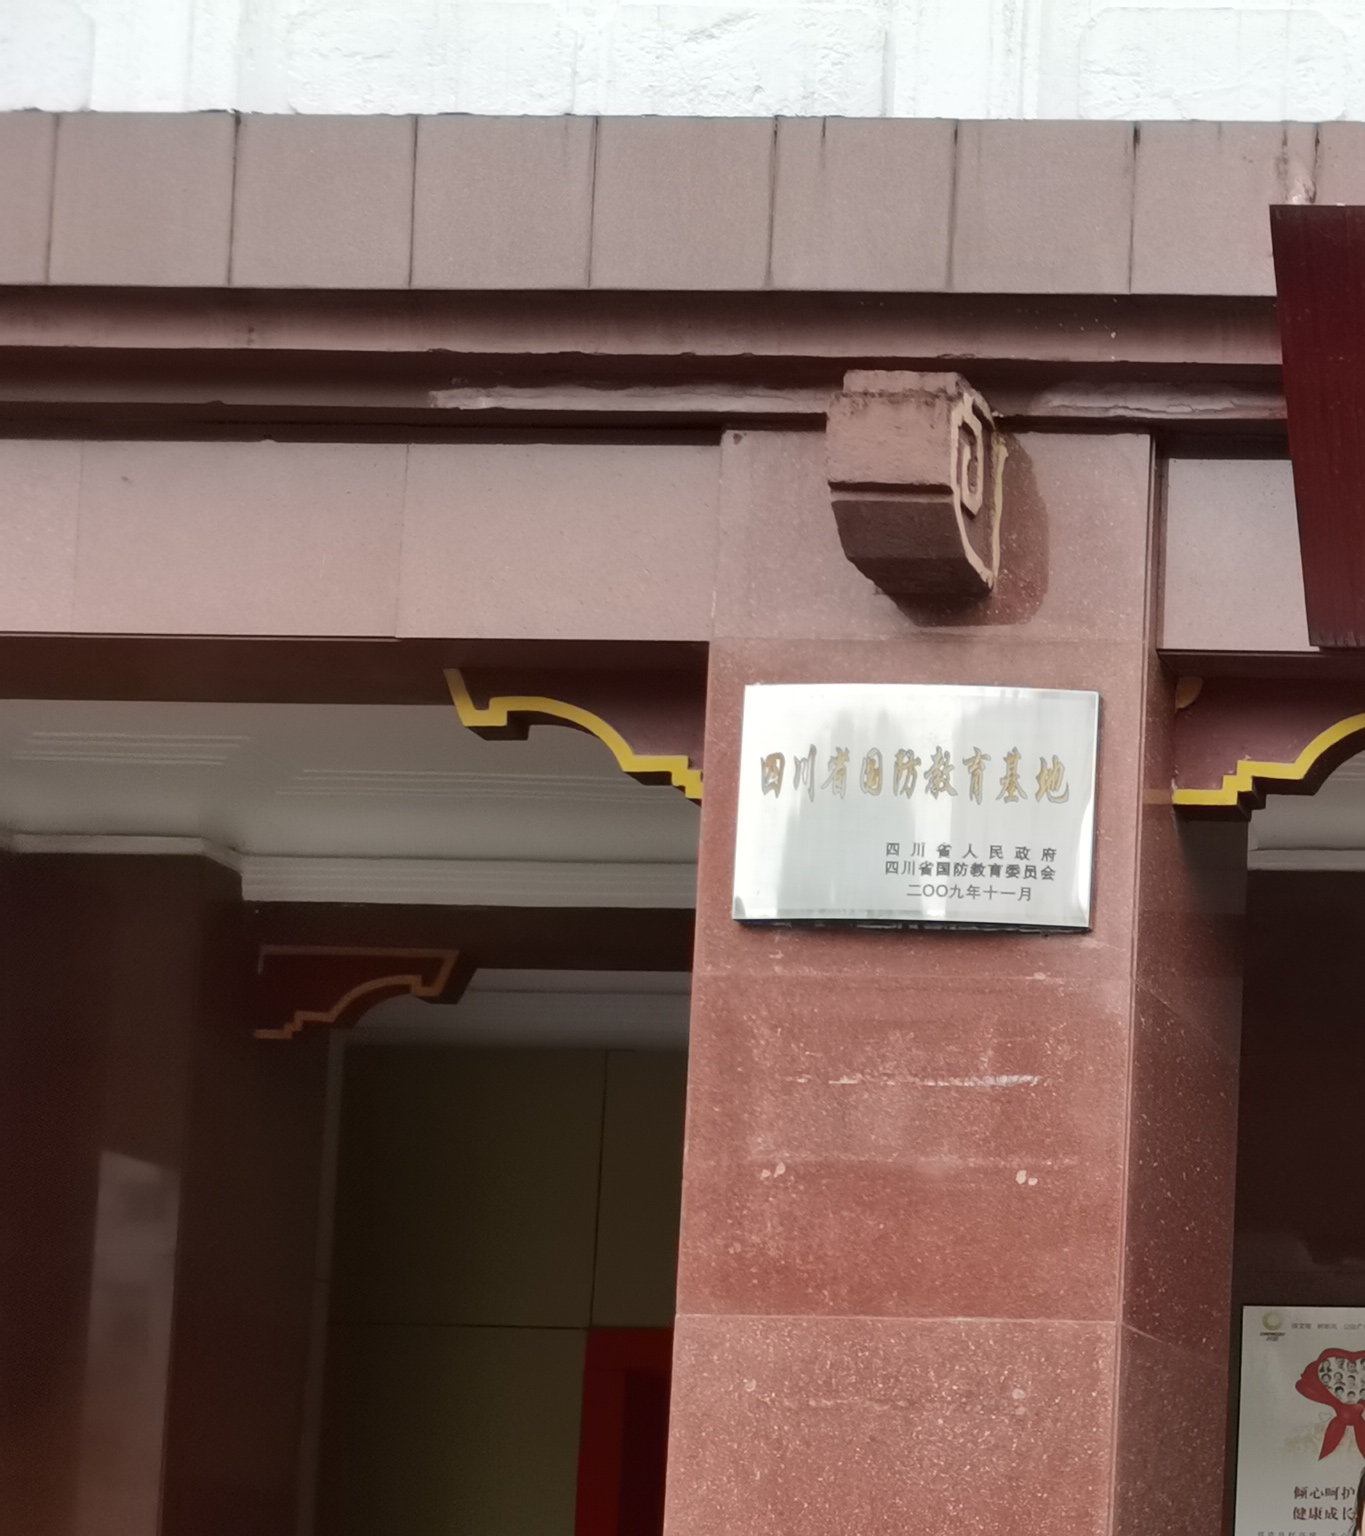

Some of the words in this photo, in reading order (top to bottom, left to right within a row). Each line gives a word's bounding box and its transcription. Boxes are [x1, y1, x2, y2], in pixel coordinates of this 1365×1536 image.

[760, 744, 1069, 805] 四川省国防教育基地
[886, 842, 1057, 862] 四川省人民政府
[885, 861, 1056, 881] 四川省国防教育委员会
